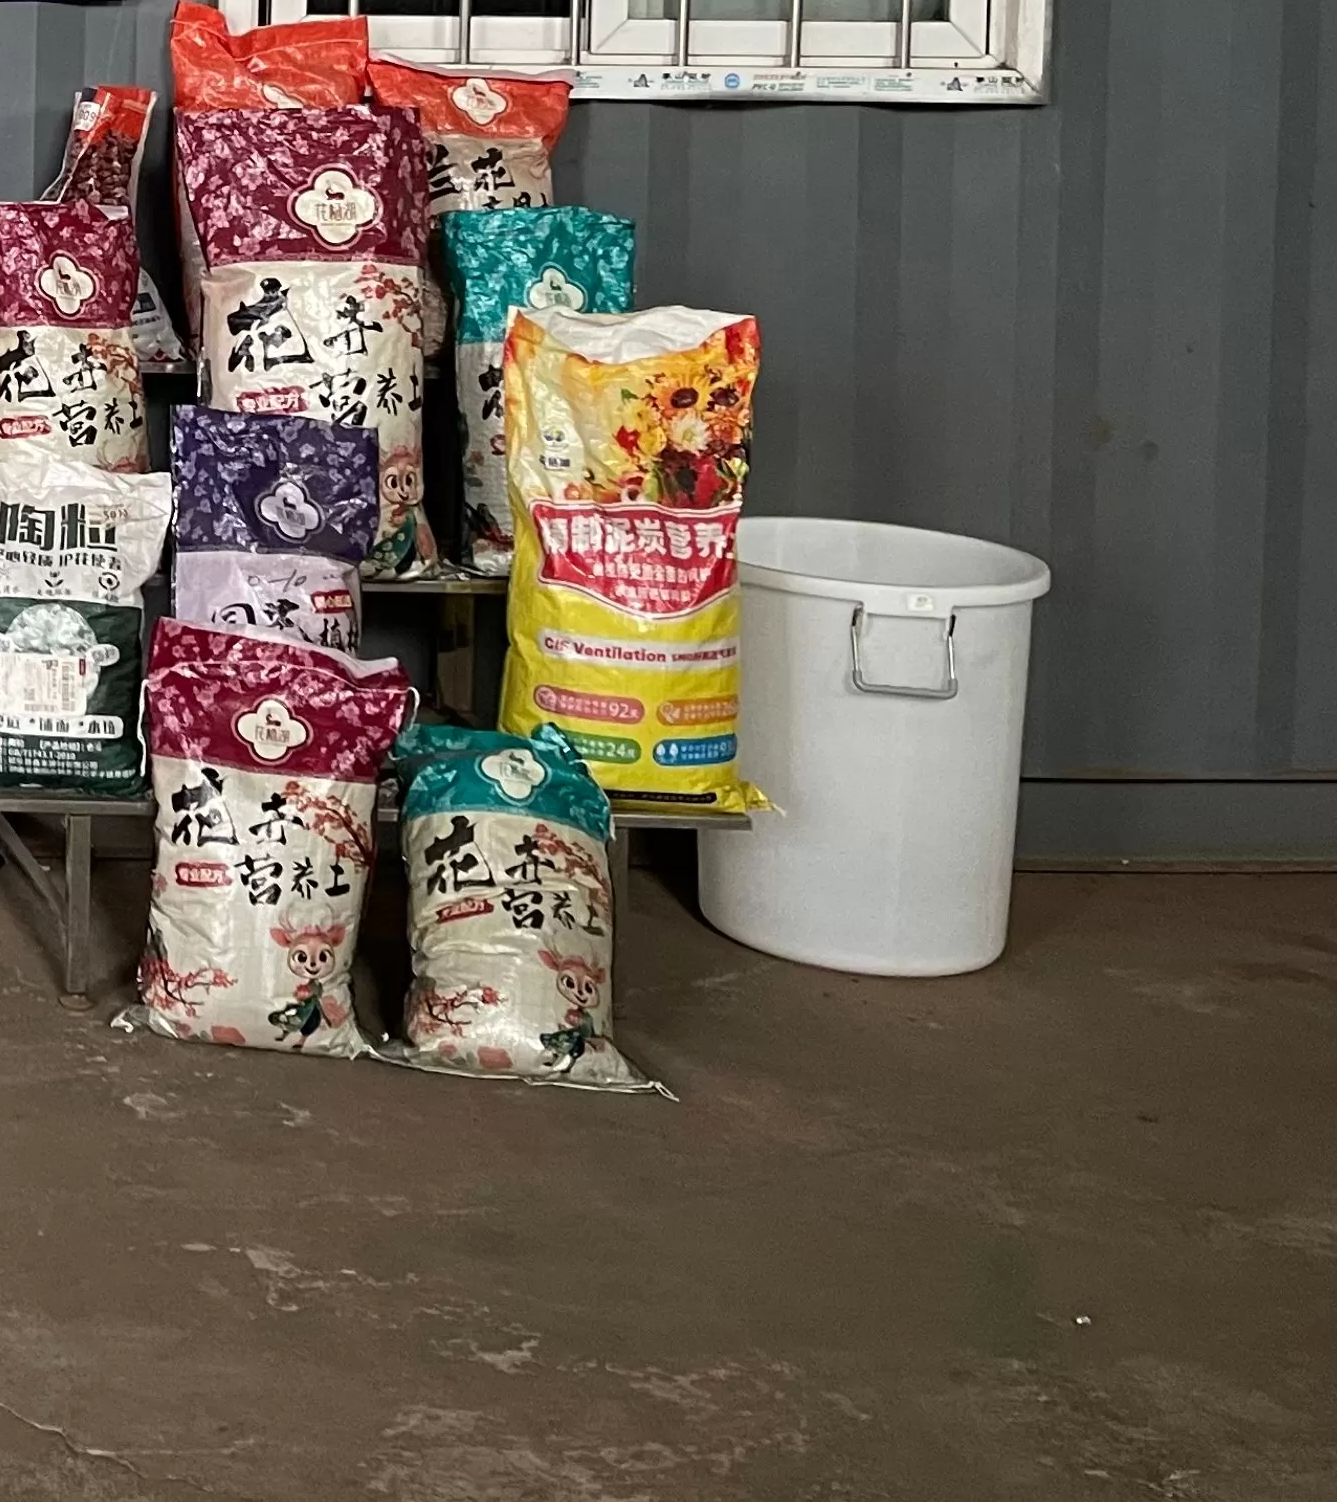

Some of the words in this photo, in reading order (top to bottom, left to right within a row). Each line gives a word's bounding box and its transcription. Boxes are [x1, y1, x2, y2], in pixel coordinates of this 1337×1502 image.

[573, 641, 667, 664] Ventilation
[234, 852, 351, 907] 营养土
